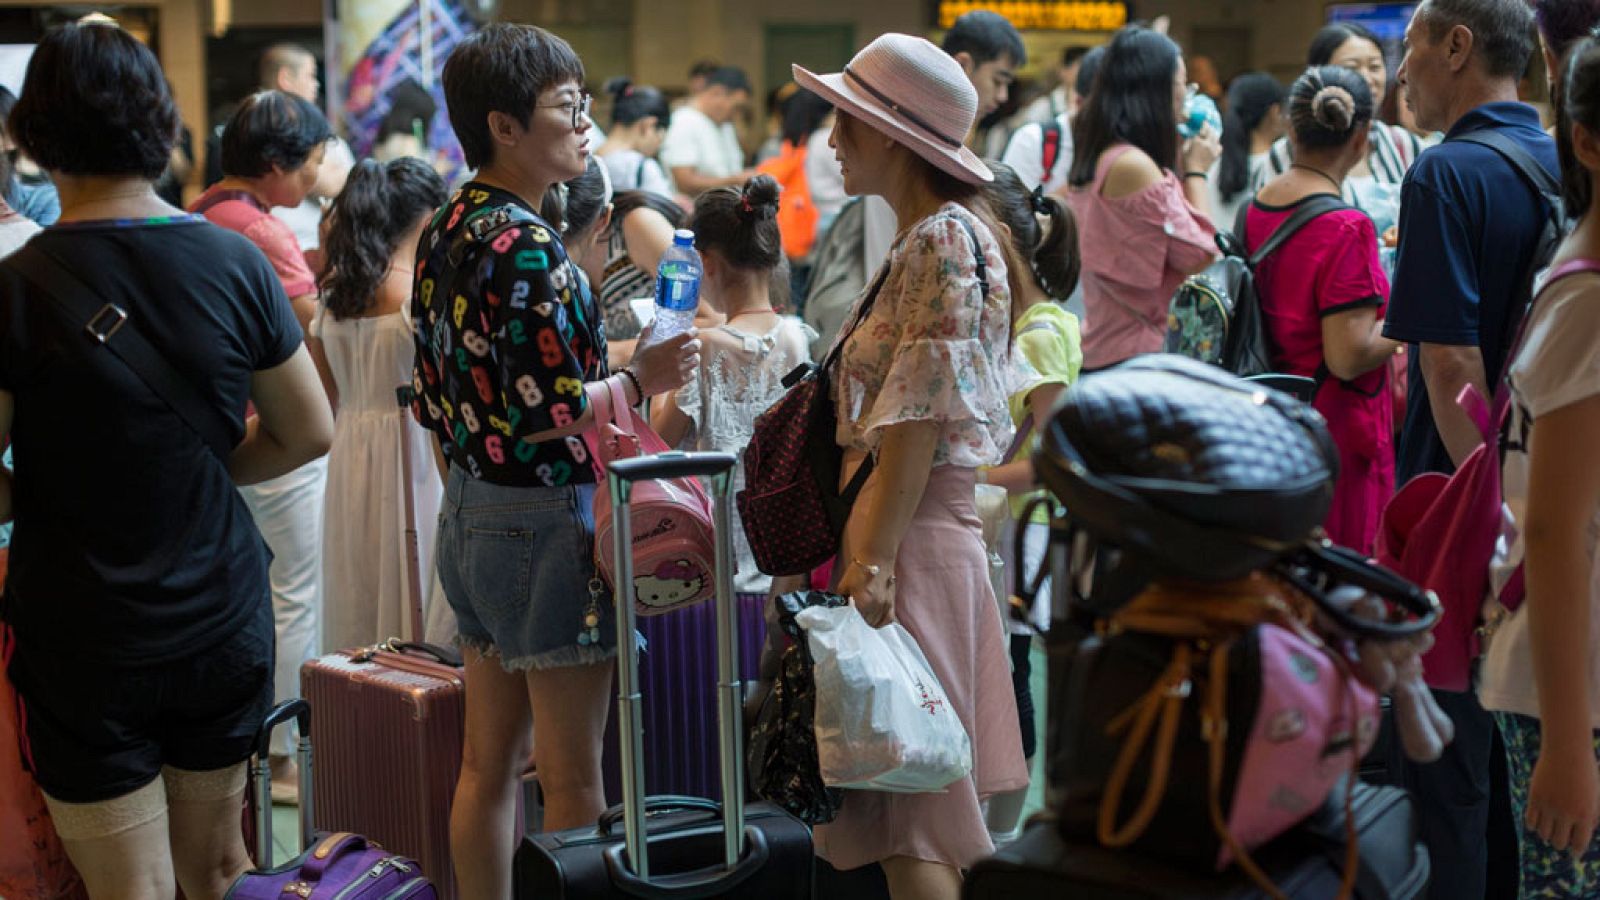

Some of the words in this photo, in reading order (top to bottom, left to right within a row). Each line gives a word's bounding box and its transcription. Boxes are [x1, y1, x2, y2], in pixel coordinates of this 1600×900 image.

[509, 280, 529, 310] 2
[508, 318, 528, 345] 2
[514, 374, 544, 408] 8
[460, 402, 480, 433] 8
[484, 434, 505, 464] 6
